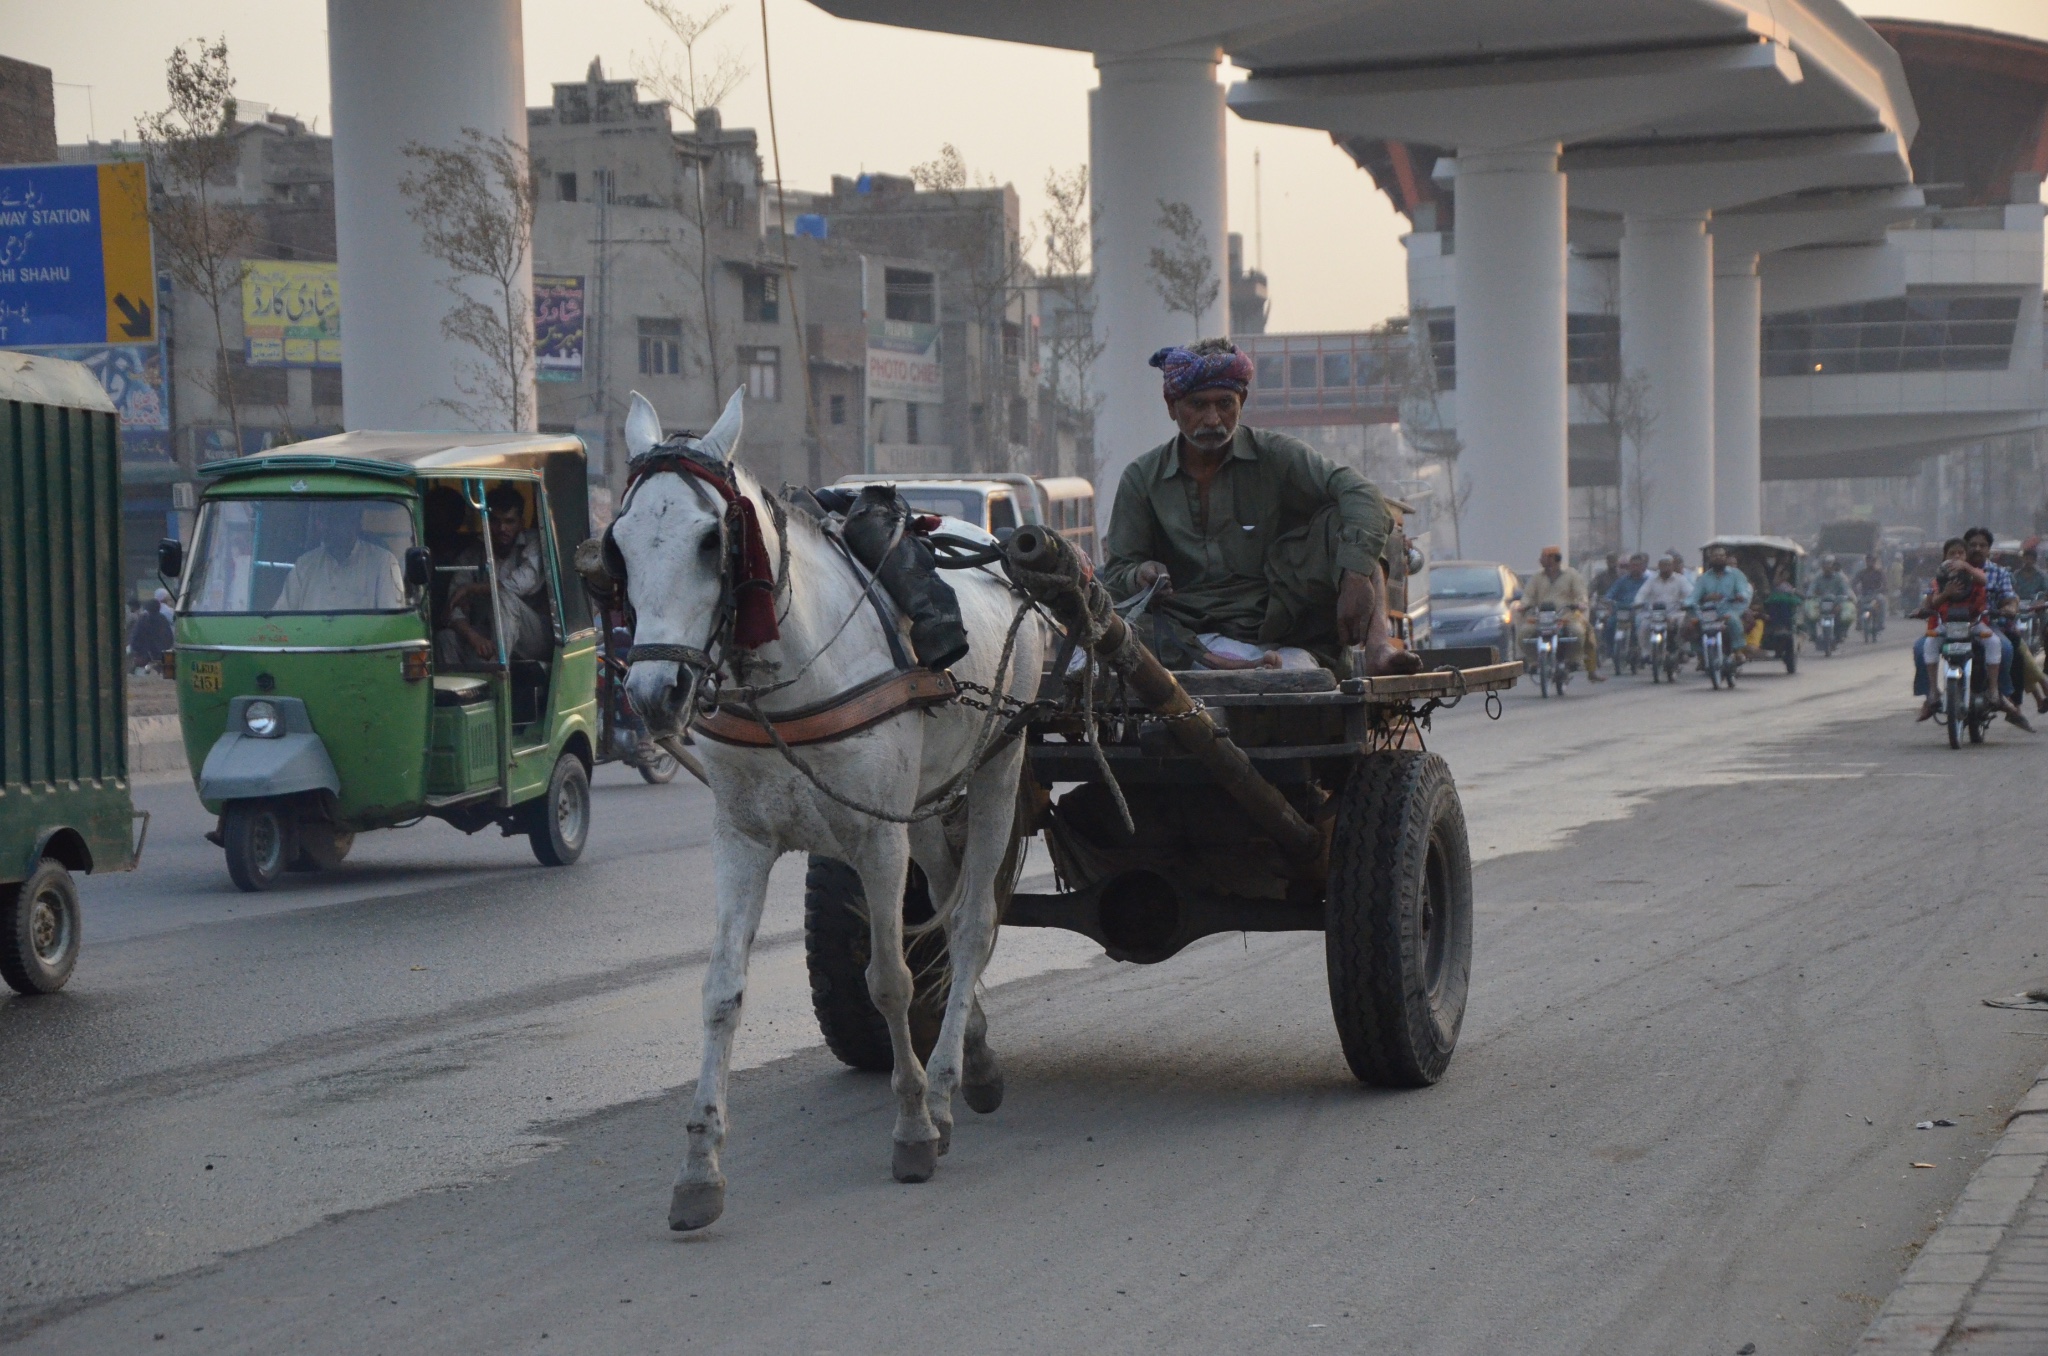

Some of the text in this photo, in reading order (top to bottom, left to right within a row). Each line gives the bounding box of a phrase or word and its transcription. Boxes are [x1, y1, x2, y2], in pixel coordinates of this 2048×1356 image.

[32, 208, 90, 226] STATION
[20, 266, 70, 283] SHAHU
[250, 281, 337, 321] شادی کارڈ
[870, 358, 908, 380] PHOTO
